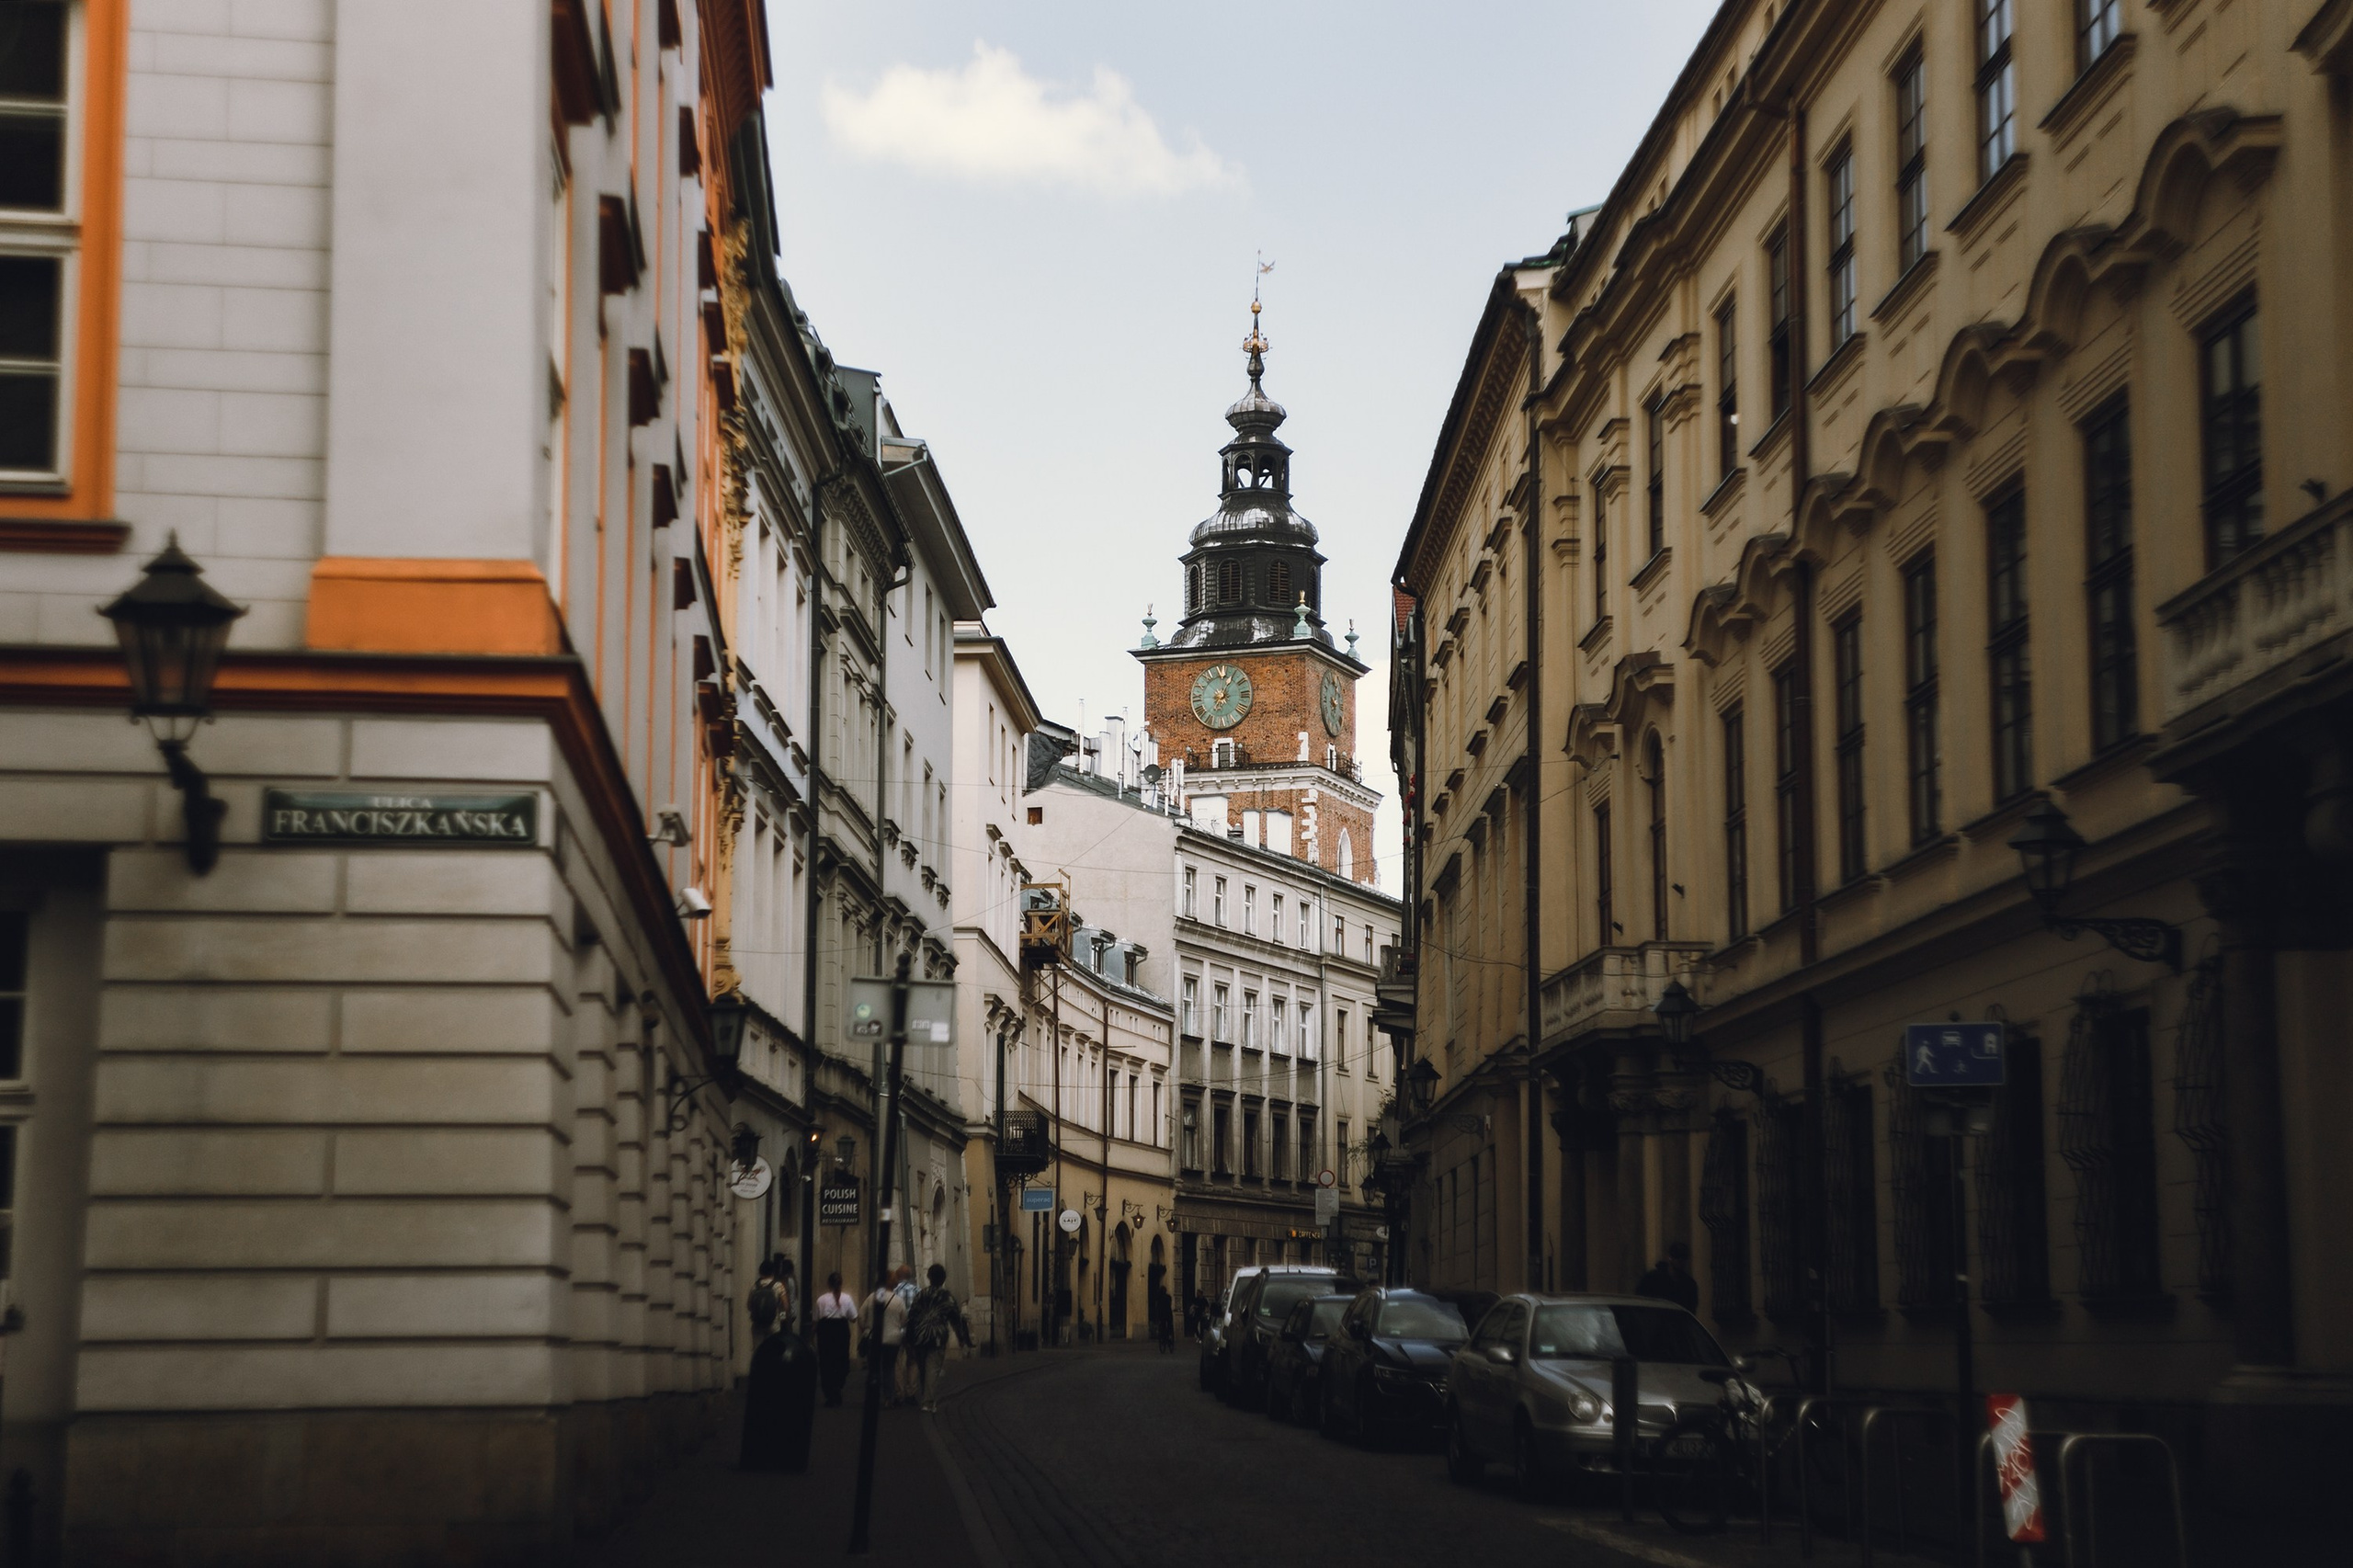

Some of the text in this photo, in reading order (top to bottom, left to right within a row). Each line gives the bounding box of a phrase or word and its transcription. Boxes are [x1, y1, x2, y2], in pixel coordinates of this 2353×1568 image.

[369, 795, 433, 809] ULICA
[275, 810, 528, 836] FRANCISZKAŃSKA
[824, 1188, 857, 1199] POLISH
[822, 1203, 858, 1214] CUISINE
